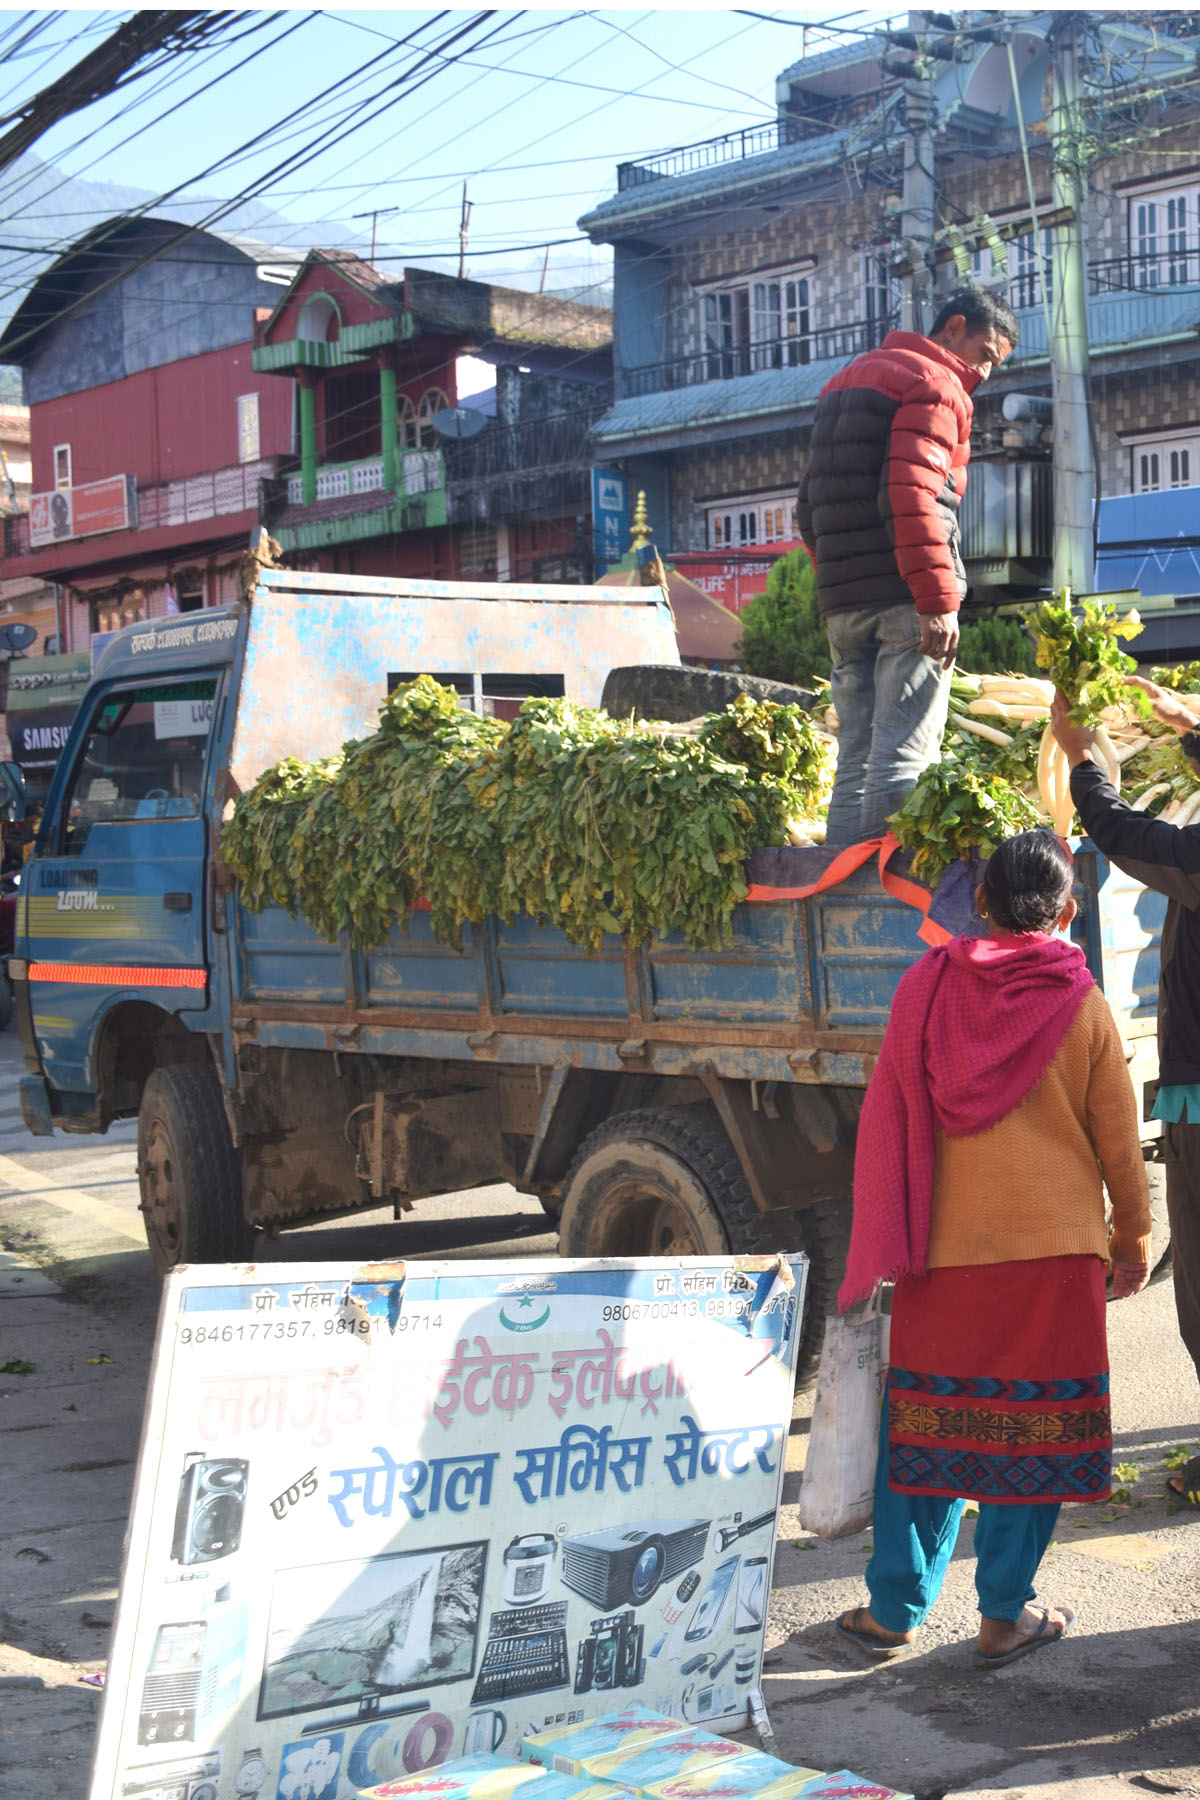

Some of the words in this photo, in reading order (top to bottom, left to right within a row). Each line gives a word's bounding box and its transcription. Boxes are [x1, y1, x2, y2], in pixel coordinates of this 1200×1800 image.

[24, 726, 72, 750] SAMSU
[41, 868, 98, 889] LOADKING
[684, 1272, 716, 1295] सहिम
[291, 1286, 336, 1312] रहिम
[328, 1445, 500, 1529] स्पेशल
[512, 1423, 654, 1505] सर्भिस
[663, 1414, 784, 1487] सेन्टर
